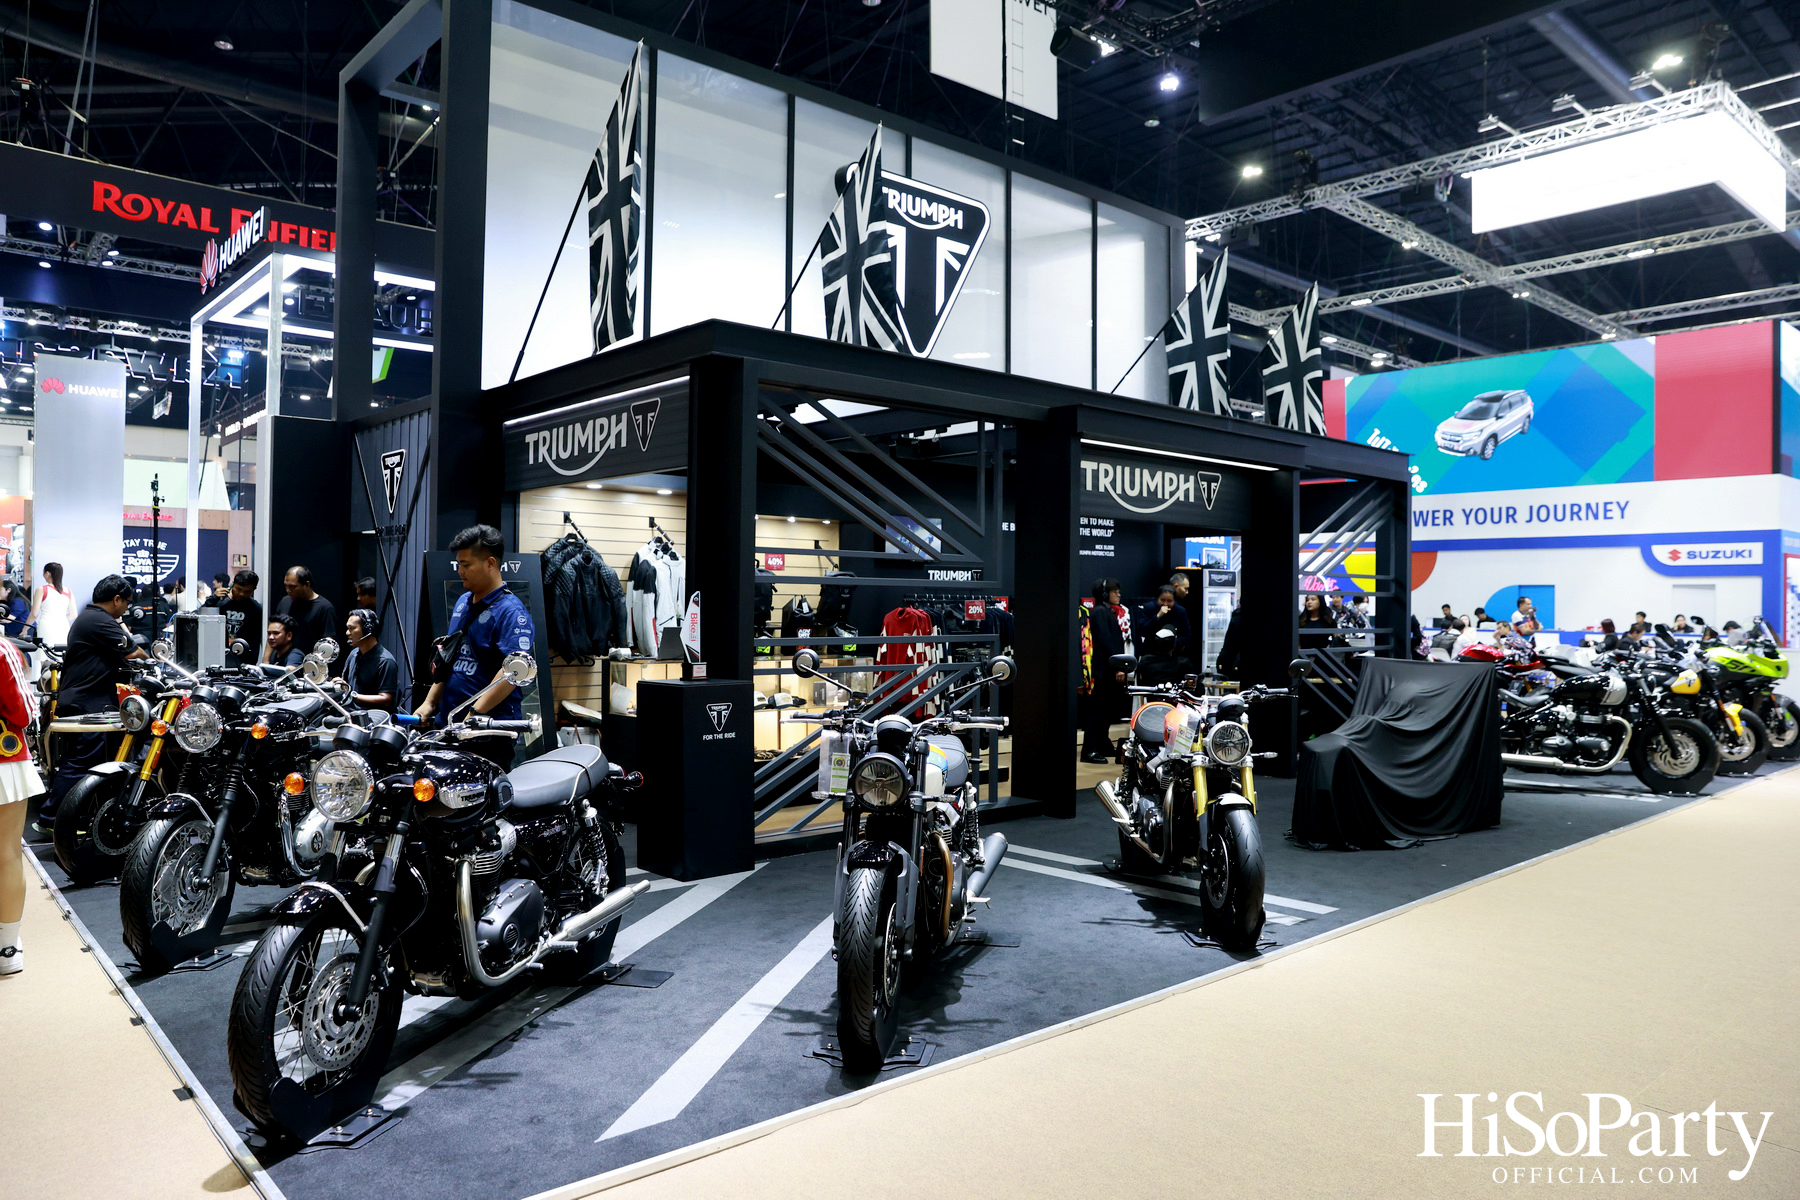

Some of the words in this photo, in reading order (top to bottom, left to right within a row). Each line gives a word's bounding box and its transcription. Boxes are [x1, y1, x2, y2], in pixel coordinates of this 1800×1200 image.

[92, 180, 220, 234] ROYAL
[219, 206, 265, 273] HUAWEI
[68, 383, 124, 399] HUAWEI
[525, 412, 628, 476] TRIUMPH
[1080, 460, 1195, 514] TRIUMPH
[1413, 509, 1455, 527] WER
[1461, 506, 1518, 526] YOUR
[1525, 500, 1630, 523] JOURNEY
[1089, 517, 1097, 526] TO
[1098, 518, 1114, 527] MAKE
[767, 557, 783, 566] 40%
[1686, 549, 1752, 560] SUZUKI
[928, 569, 972, 581] TRIUMPH
[968, 605, 983, 614] 20%
[690, 612, 698, 634] Bike
[724, 731, 736, 739] RIDE
